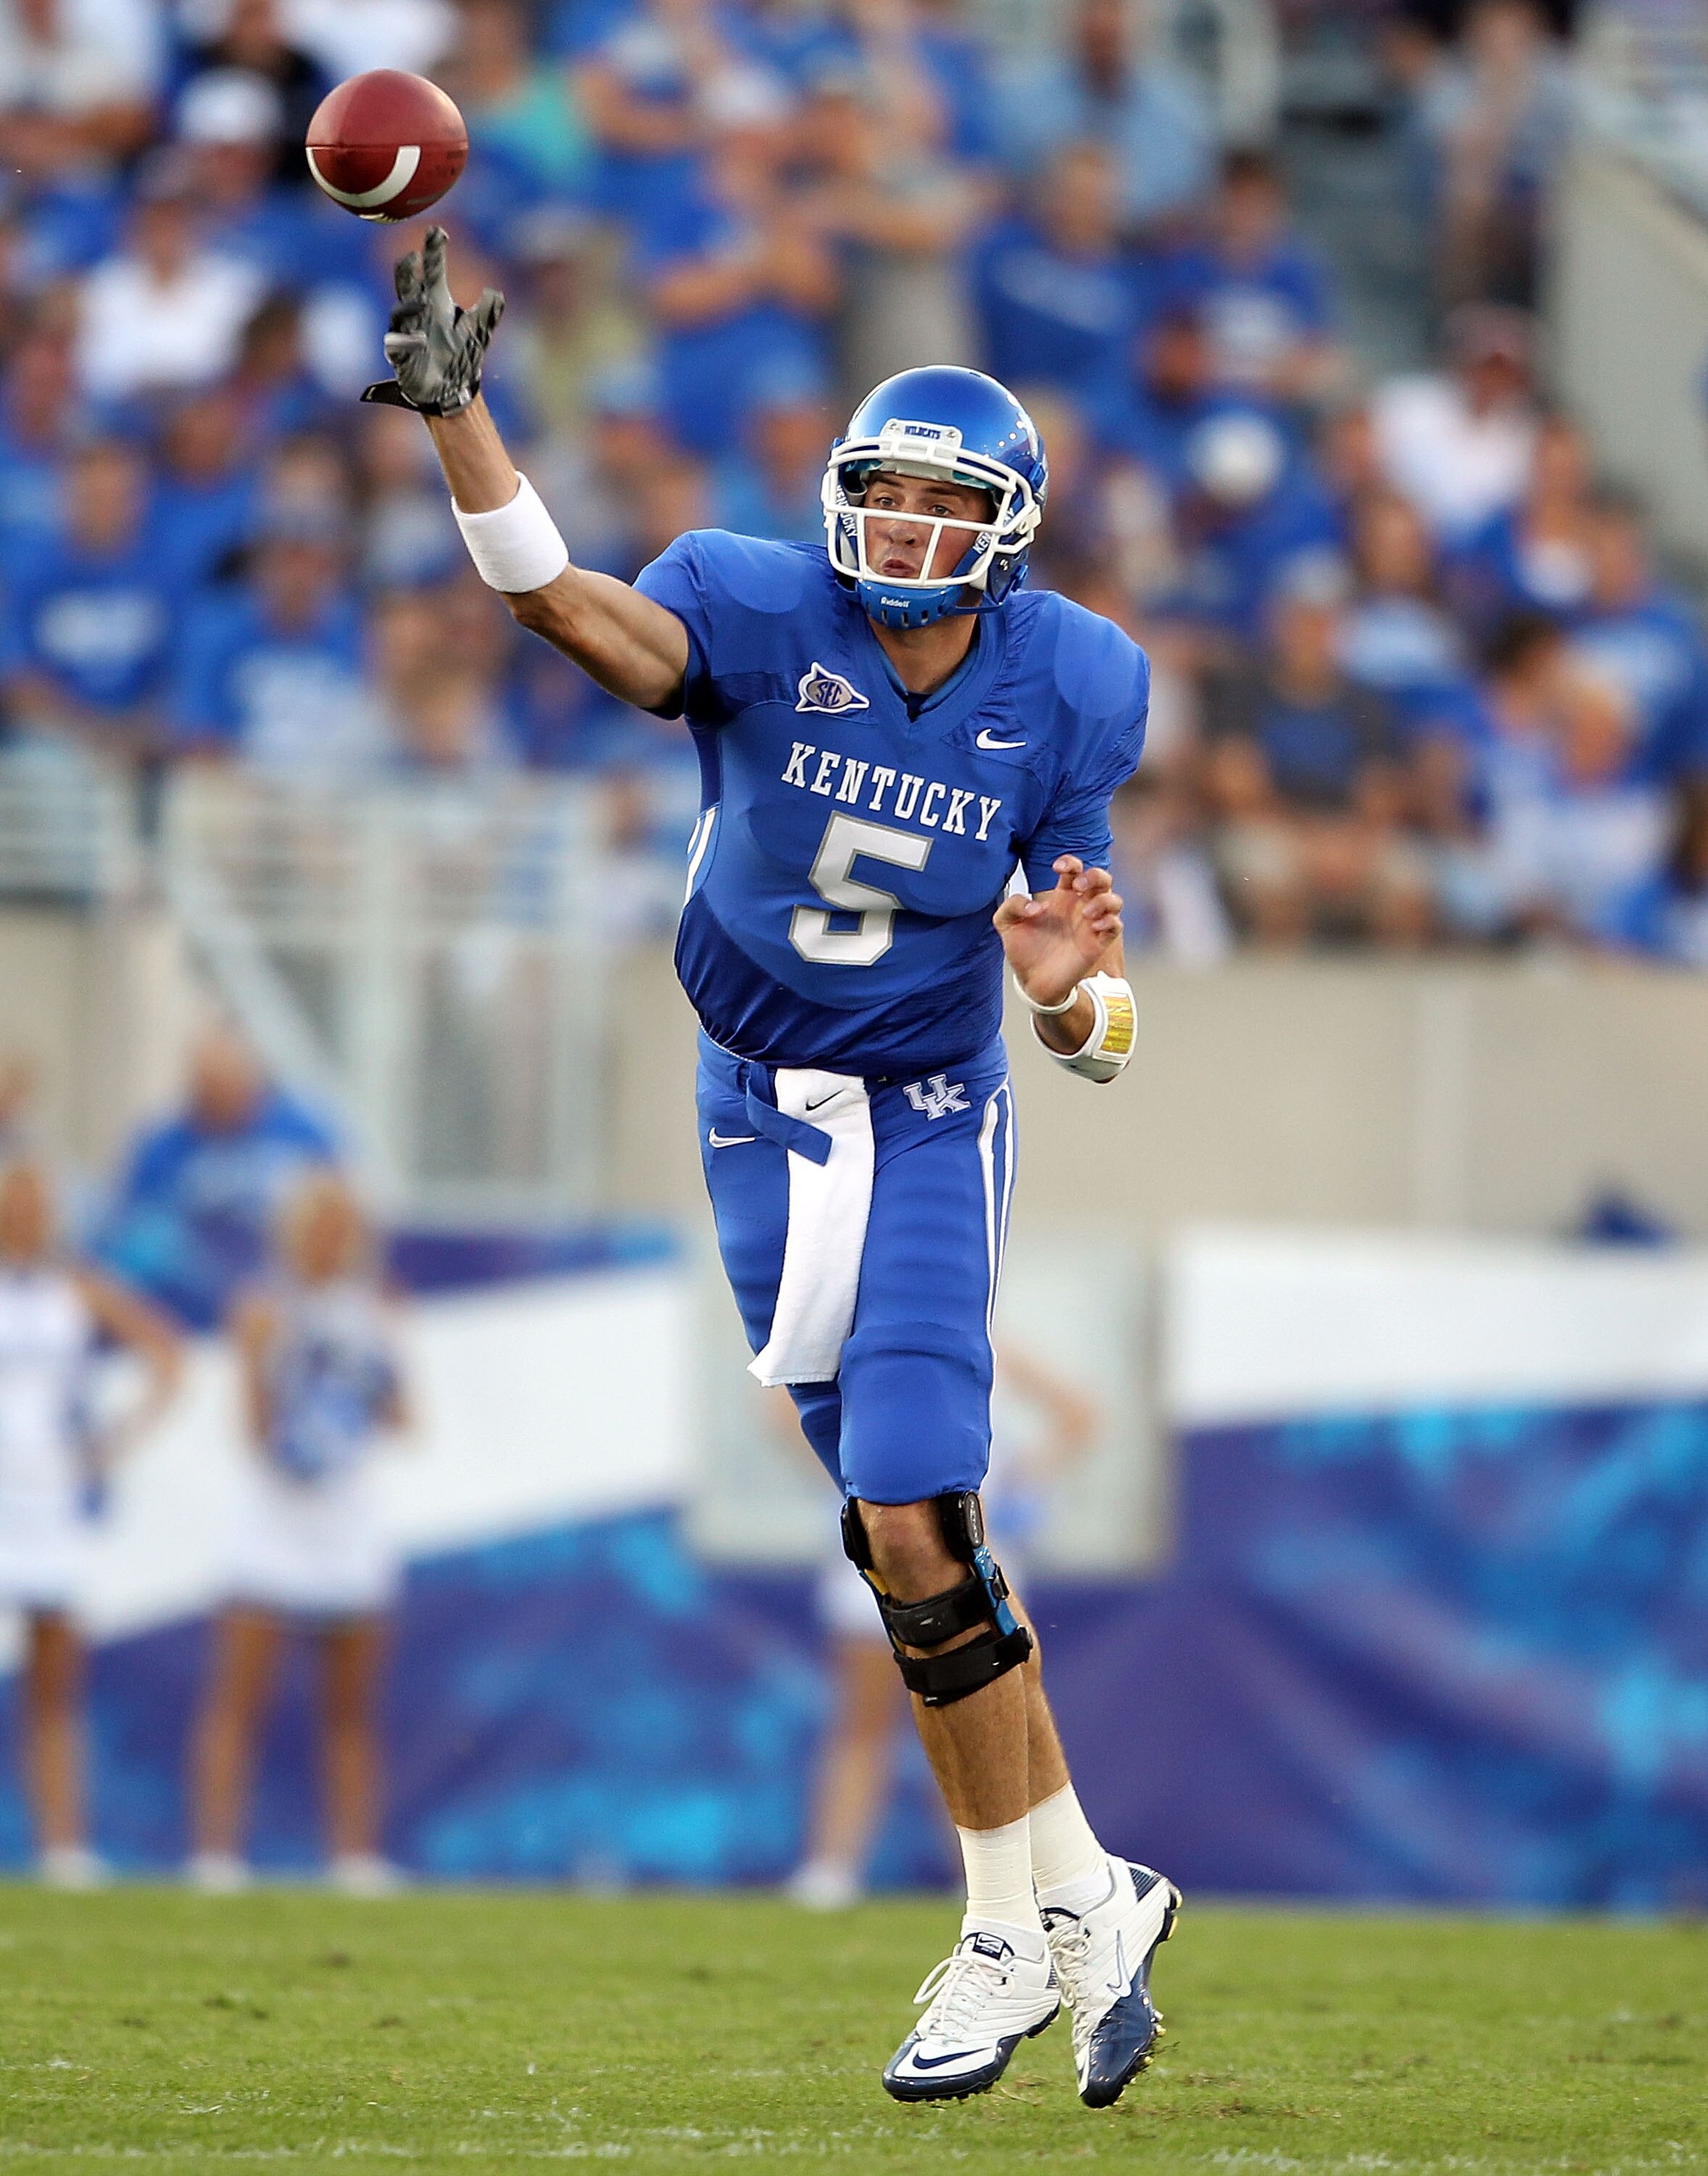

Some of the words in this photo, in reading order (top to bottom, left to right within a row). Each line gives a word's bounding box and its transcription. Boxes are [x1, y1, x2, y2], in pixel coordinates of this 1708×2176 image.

[880, 596, 911, 608] Riddell
[815, 681, 842, 706] SEC
[780, 741, 1002, 841] KENTUCKY
[788, 809, 935, 967] 5
[902, 1073, 972, 1121] UK
